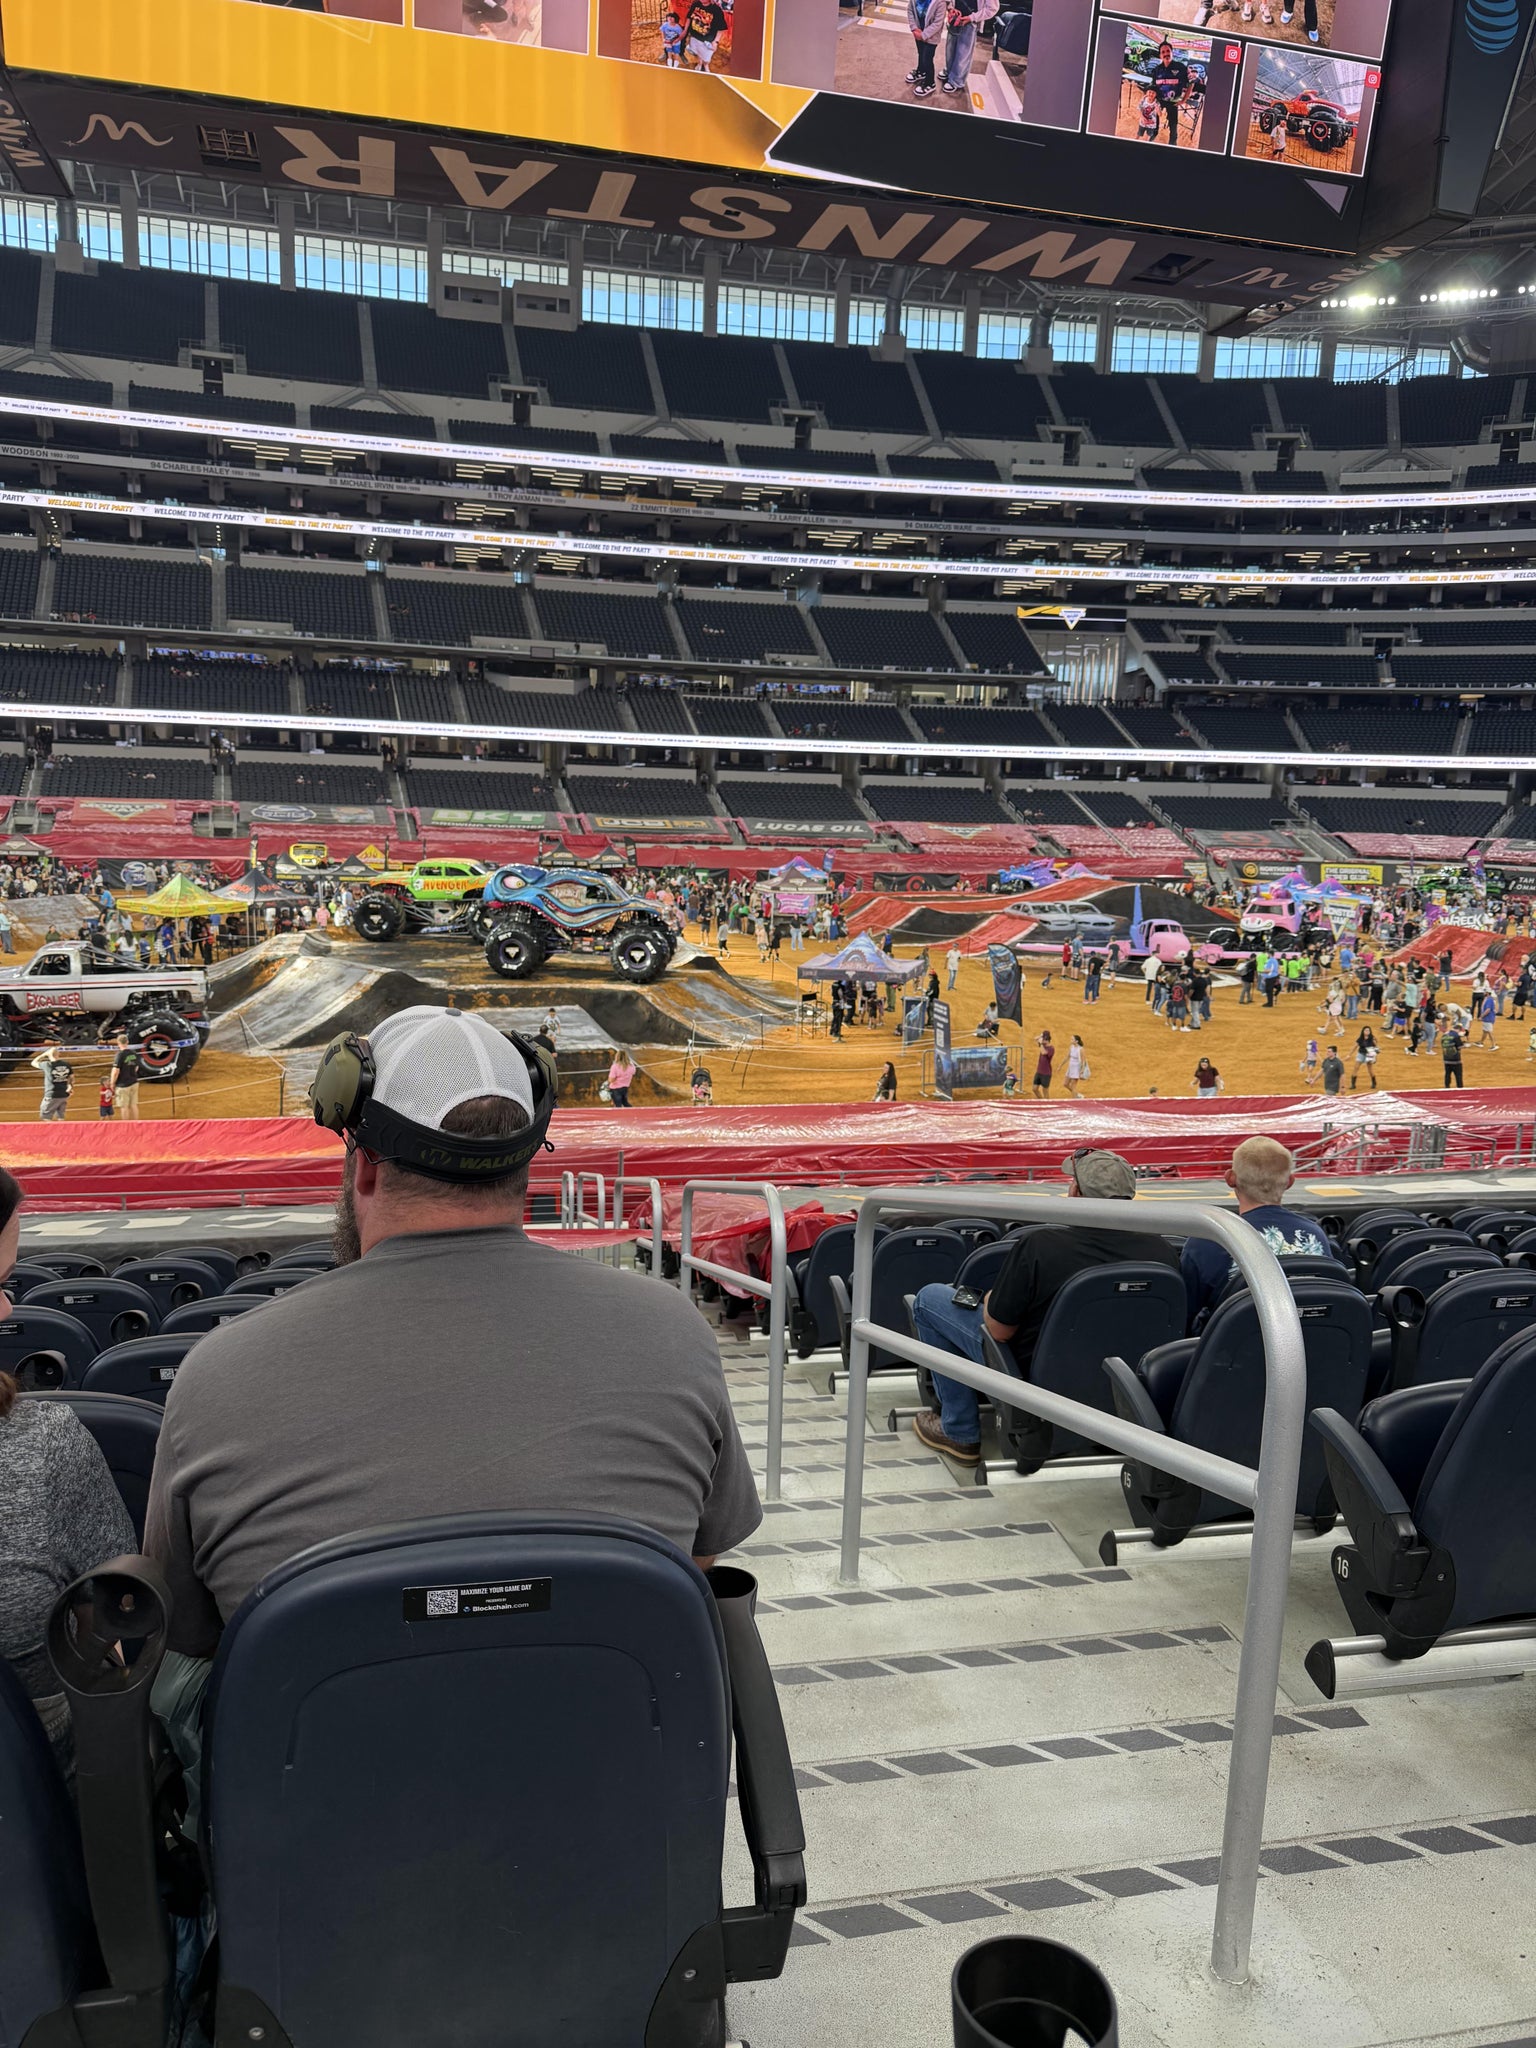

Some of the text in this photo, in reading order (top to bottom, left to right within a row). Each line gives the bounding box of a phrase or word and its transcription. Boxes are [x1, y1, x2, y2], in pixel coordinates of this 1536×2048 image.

[273, 126, 1136, 286] WINSTAR
[1, 446, 48, 458] WOODSON
[151, 461, 161, 469] 94
[162, 461, 201, 473] CHARLES
[203, 466, 230, 475] HALEY
[340, 479, 373, 488] MICHAEL
[376, 482, 394, 490] IRVIN
[2, 494, 26, 502] PARTY
[154, 508, 187, 516] WELCOME
[224, 513, 245, 521] PARTY
[779, 514, 802, 522] LARRY
[372, 526, 401, 535] WELCOME
[435, 530, 456, 538] PARTY
[573, 542, 601, 550] WELCOME
[632, 546, 652, 554] PARTY
[755, 822, 865, 833] LUCAS OIL
[423, 879, 468, 891] AVENGER
[1440, 914, 1483, 927] WRECK
[26, 992, 82, 1011] EXCALIBER
[1123, 1471, 1131, 1488] 15
[1336, 1556, 1349, 1579] 16
[460, 1588, 489, 1596] MAXIMIZE
[489, 1586, 504, 1594] YOUR
[472, 1603, 530, 1612] Blockchain.com
